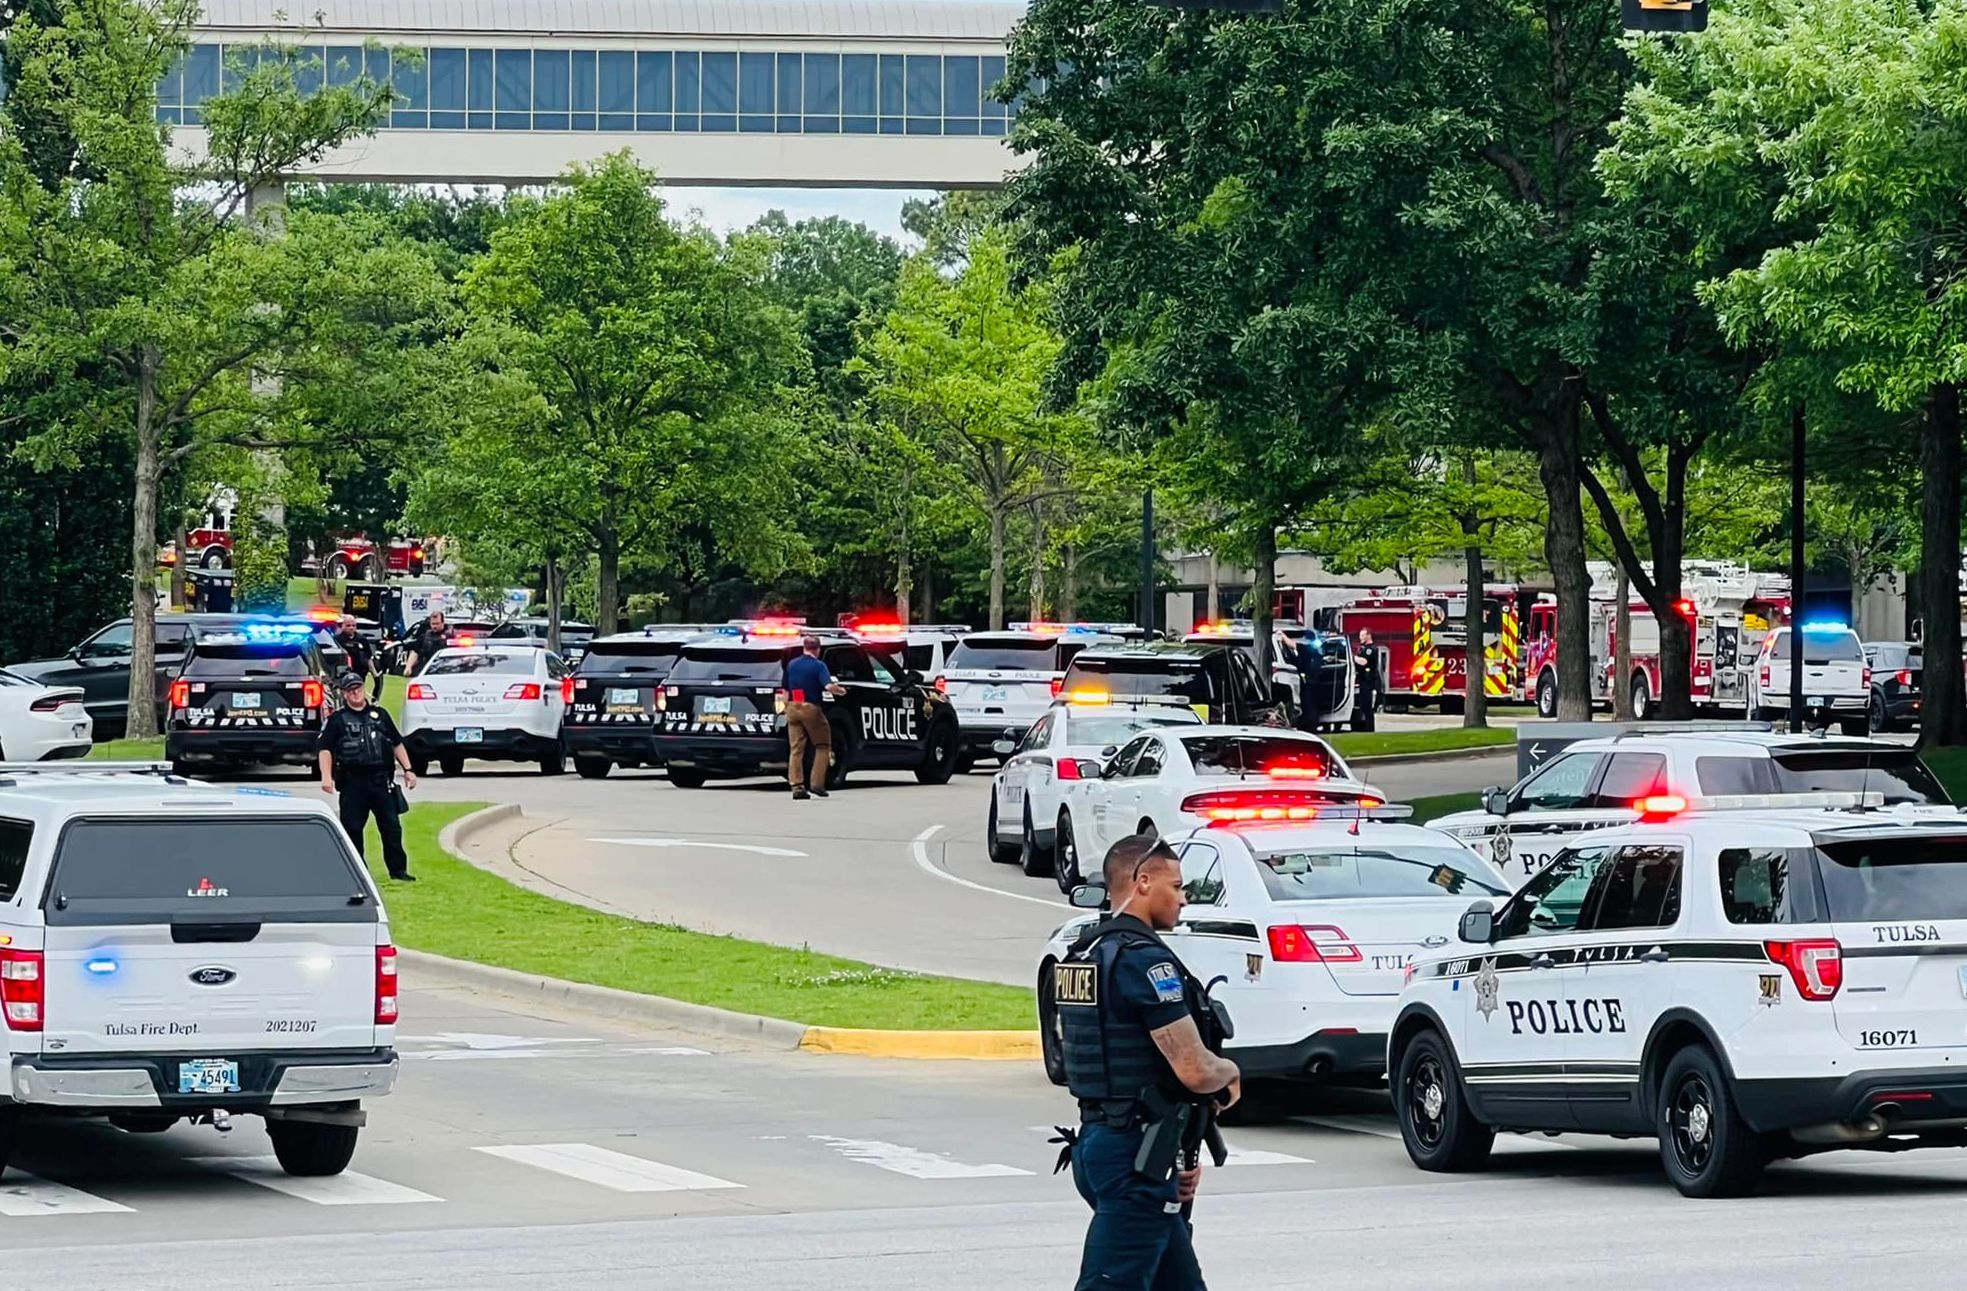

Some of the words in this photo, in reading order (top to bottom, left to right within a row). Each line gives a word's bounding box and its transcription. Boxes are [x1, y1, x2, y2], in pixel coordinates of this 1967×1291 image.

[188, 707, 215, 717] TULSA
[276, 707, 304, 716] POLICE
[574, 703, 596, 712] TULSA
[665, 711, 688, 721] TULSA
[745, 713, 774, 723] POLICE
[861, 706, 918, 740] POLICE
[187, 888, 229, 897] LEER
[1873, 925, 1941, 943] TULSA
[1573, 946, 1635, 963] TULSA
[1371, 954, 1414, 970] TUL
[200, 969, 226, 981] Ford
[1056, 968, 1092, 1001] POLICE
[1506, 998, 1627, 1035] POLICE
[105, 1024, 137, 1036] Tulsa
[141, 1023, 166, 1035] Fire
[169, 1022, 200, 1036] Dept.
[265, 1020, 318, 1033] 2021207
[1860, 1030, 1918, 1046] 16071
